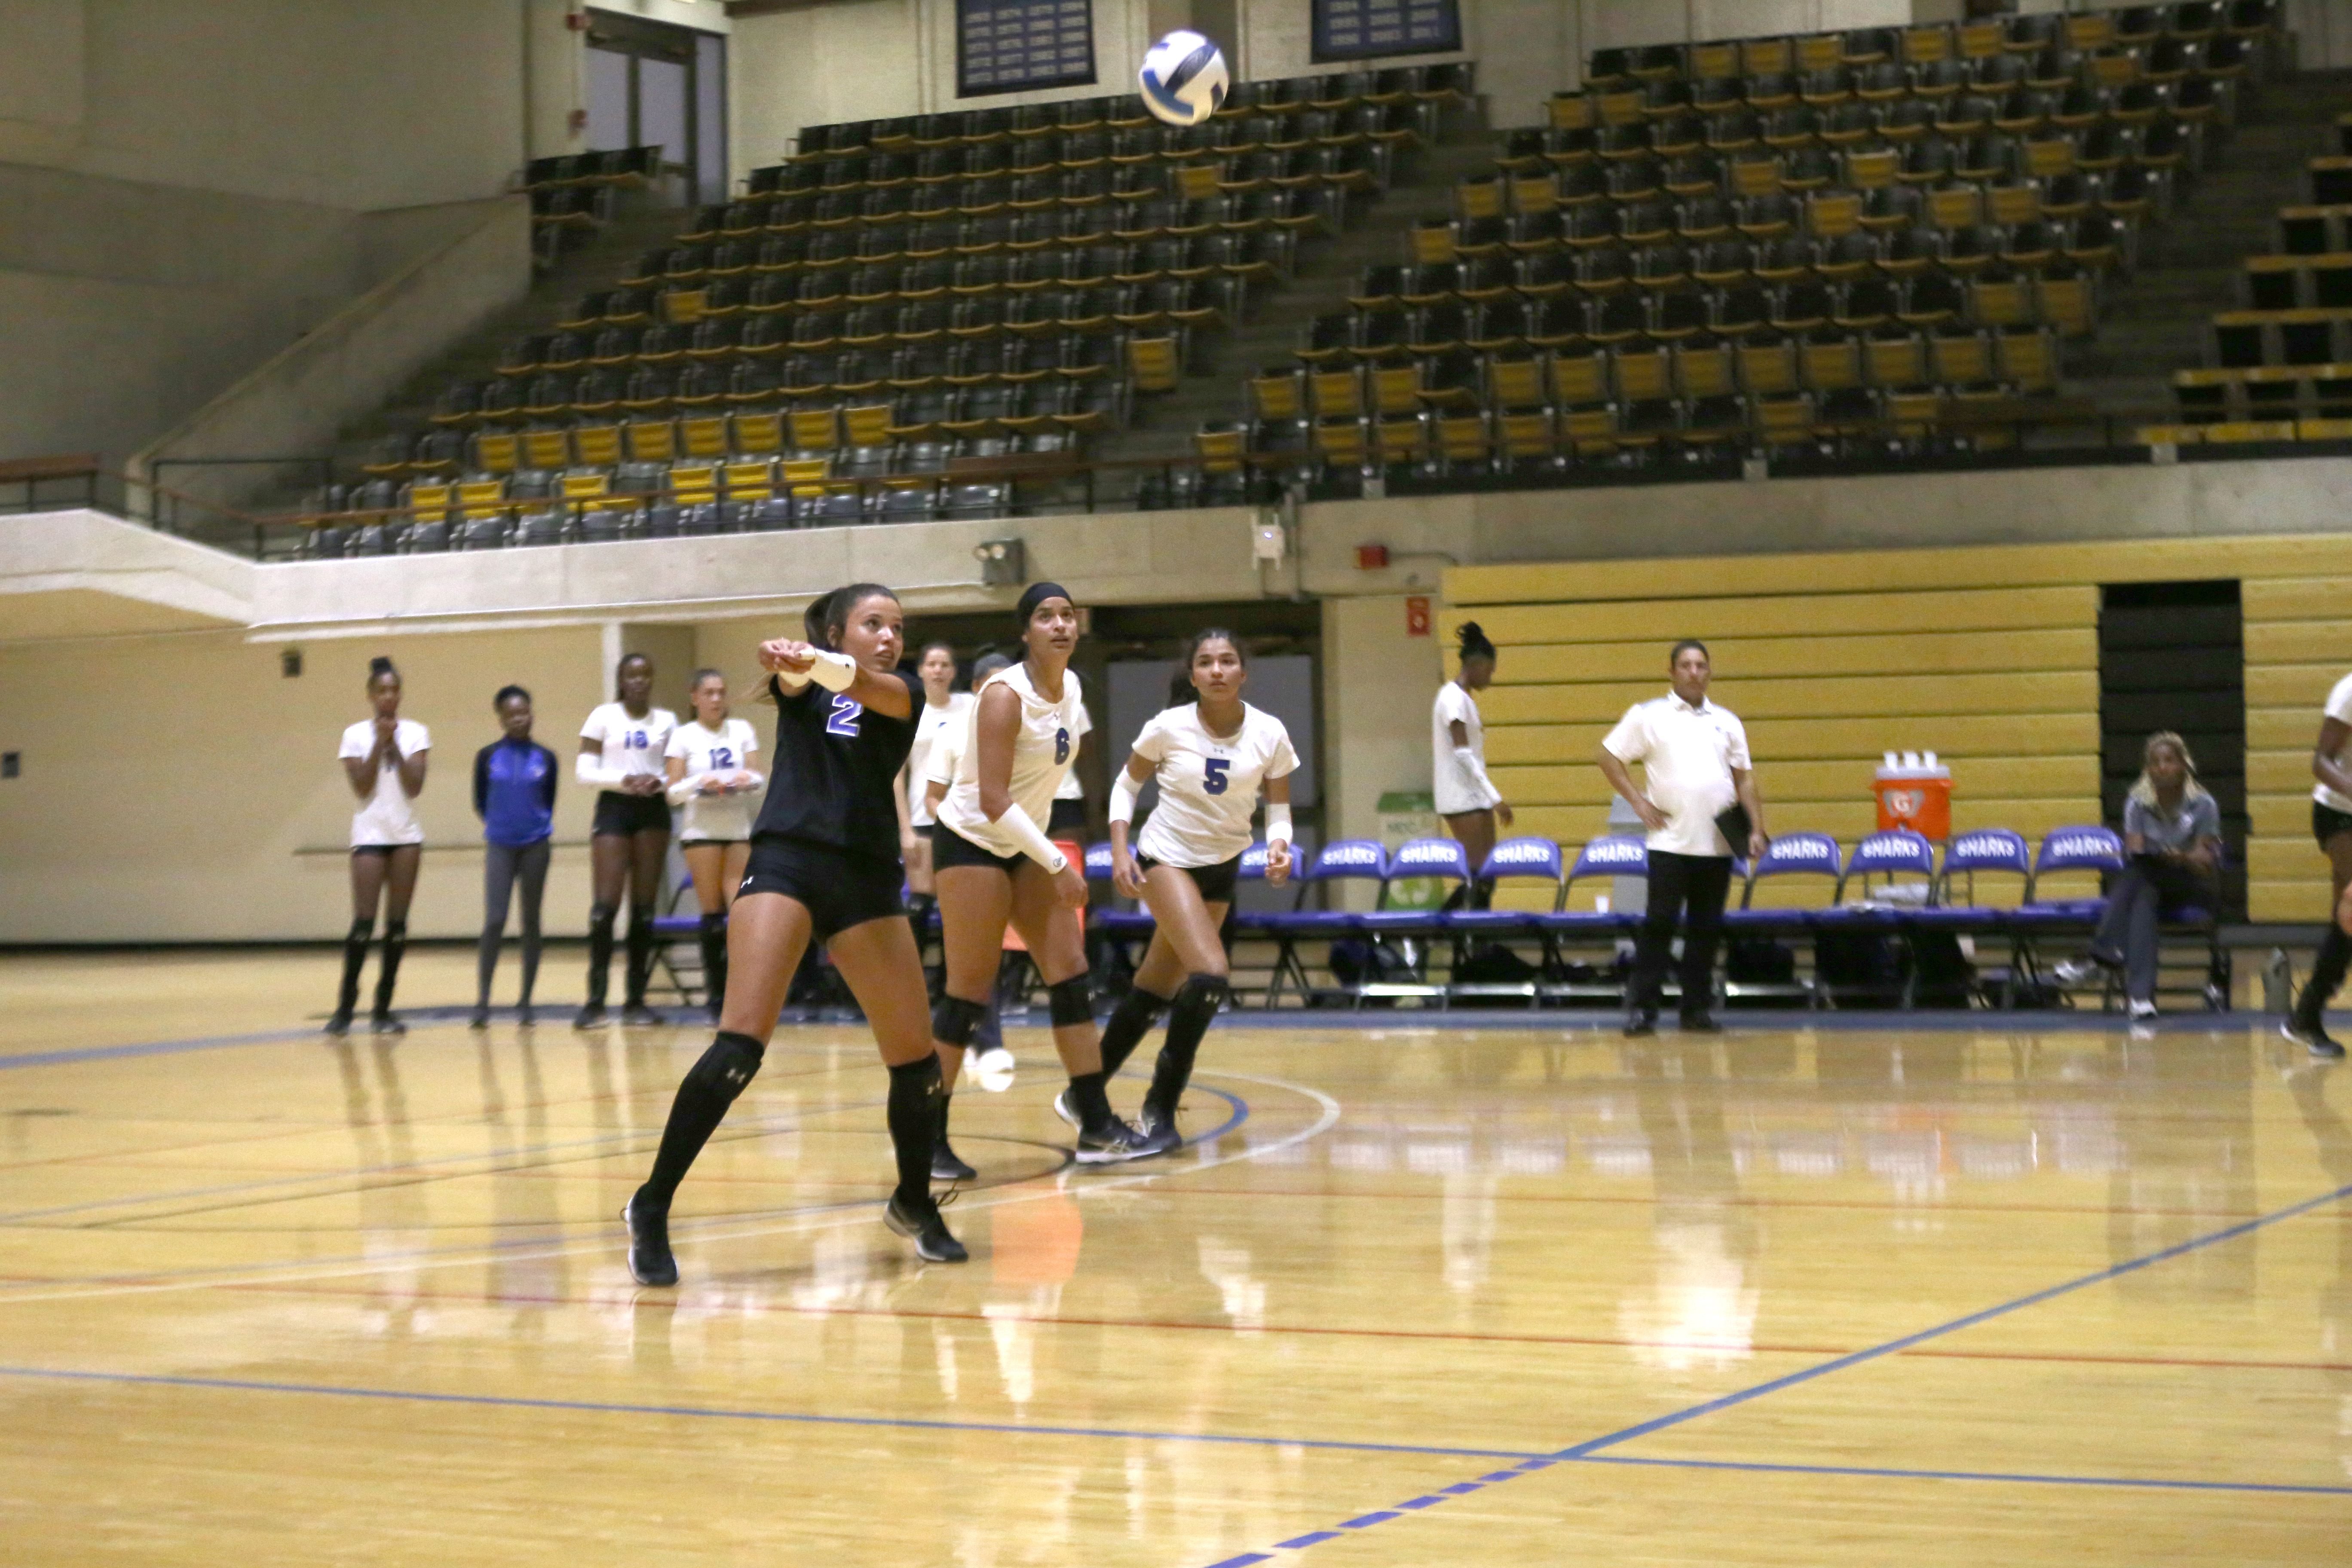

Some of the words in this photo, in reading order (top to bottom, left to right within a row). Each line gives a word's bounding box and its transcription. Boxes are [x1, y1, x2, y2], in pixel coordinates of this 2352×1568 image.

[826, 694, 862, 737] 2
[1054, 727, 1069, 765] 6
[709, 747, 734, 770] 12
[1203, 758, 1230, 795] 5
[1323, 847, 1376, 865] SHARKS
[1400, 845, 1458, 863] SHARKS
[1493, 844, 1550, 863] SHARKS
[1587, 843, 1644, 863] SHARKS
[1770, 838, 1829, 860] SHARKS
[1861, 837, 1920, 858] SHARKS
[1955, 836, 2016, 857] SHARKS
